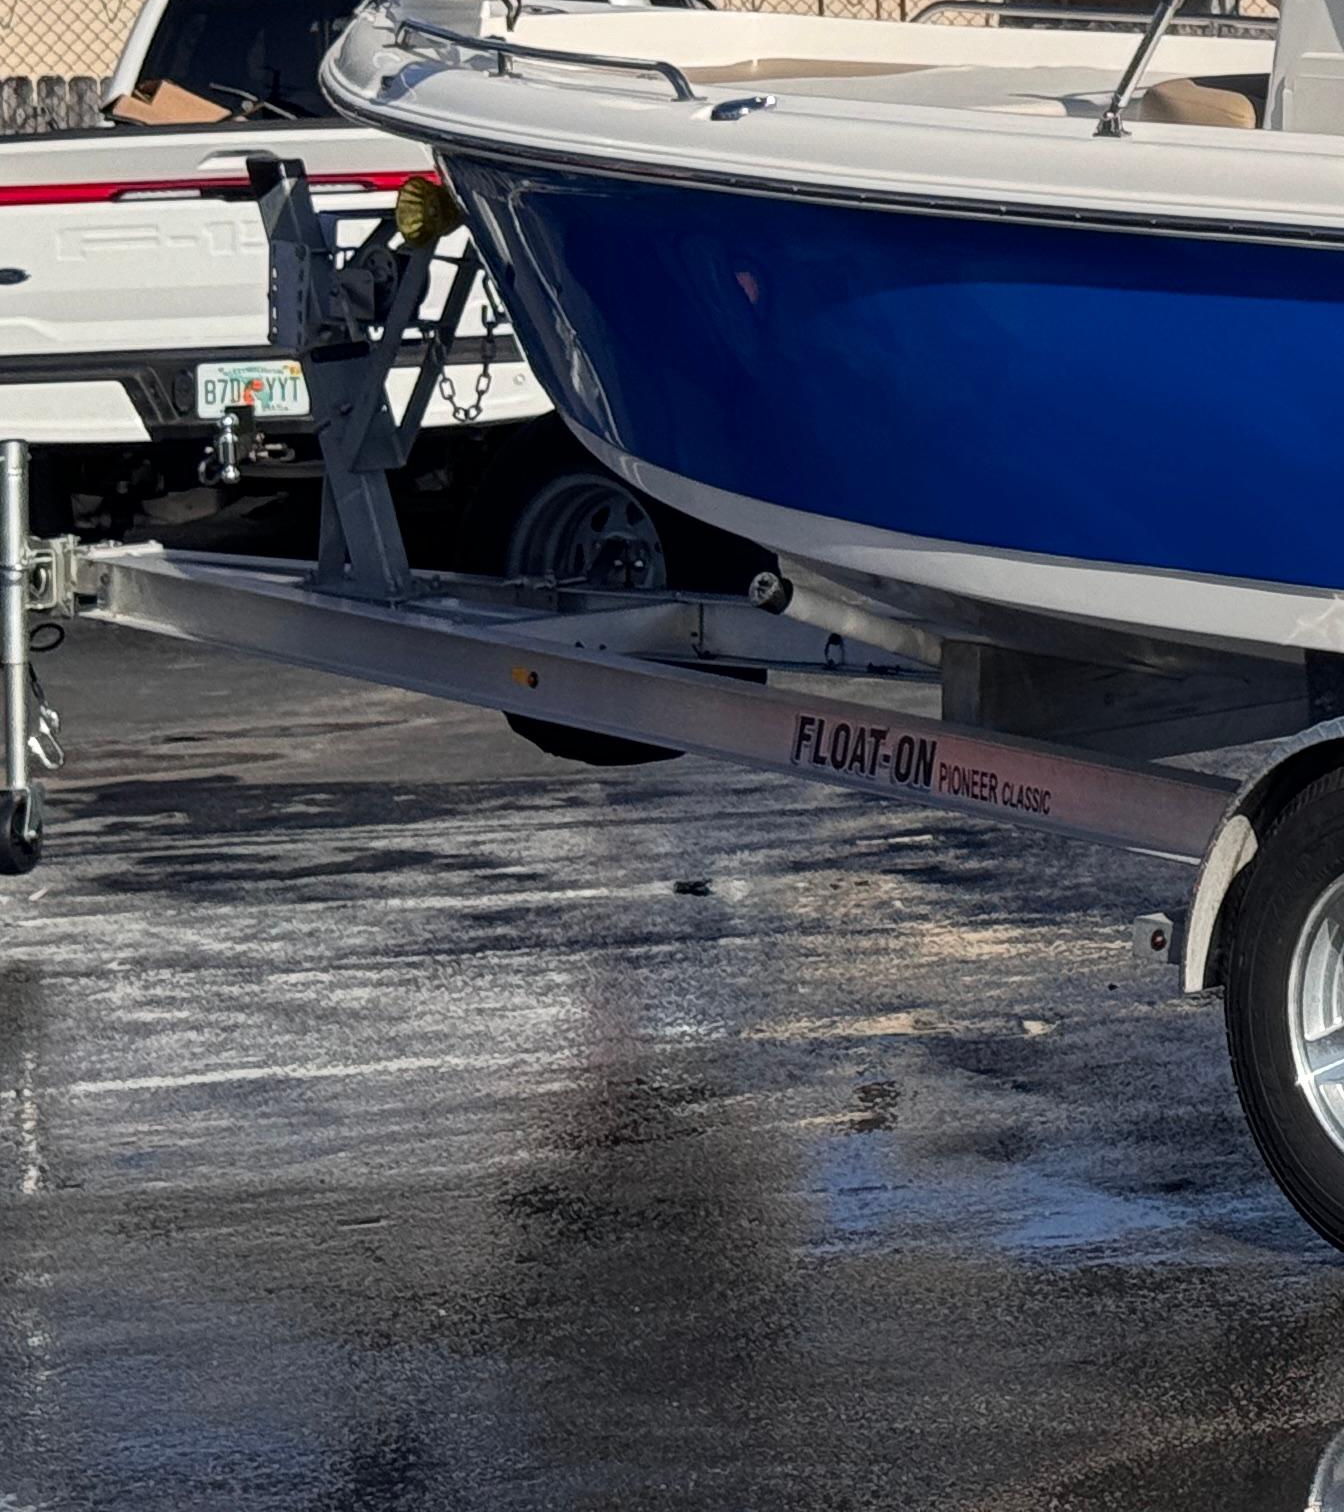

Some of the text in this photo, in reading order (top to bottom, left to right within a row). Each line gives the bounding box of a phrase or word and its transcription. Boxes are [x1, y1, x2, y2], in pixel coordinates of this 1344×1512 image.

[793, 715, 1053, 816] FLOAT-ON PIONEER CLASSIC
